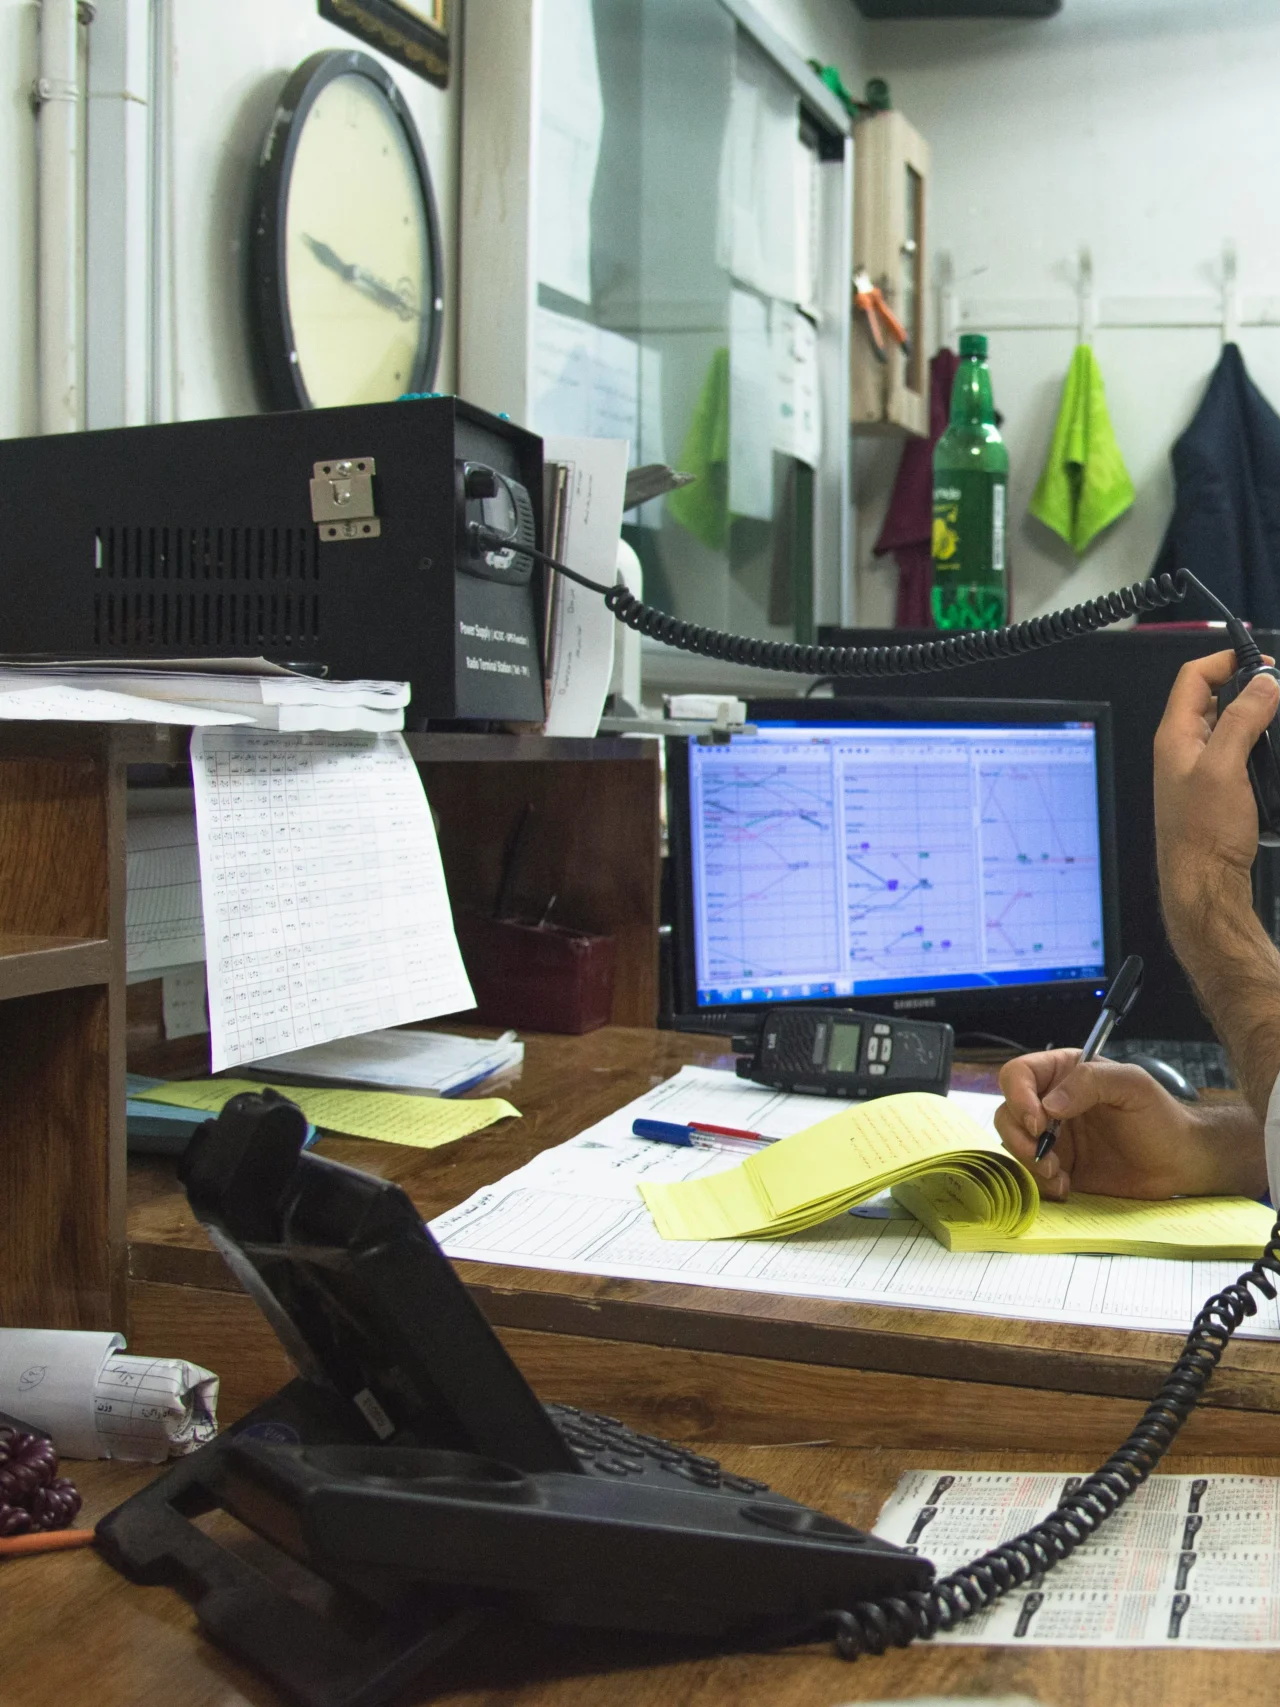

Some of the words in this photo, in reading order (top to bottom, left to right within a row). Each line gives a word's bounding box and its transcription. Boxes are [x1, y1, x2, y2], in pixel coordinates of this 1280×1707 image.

[460, 621, 475, 636] Power
[475, 624, 490, 642] Supply
[893, 997, 936, 1010] SAMSUNG
